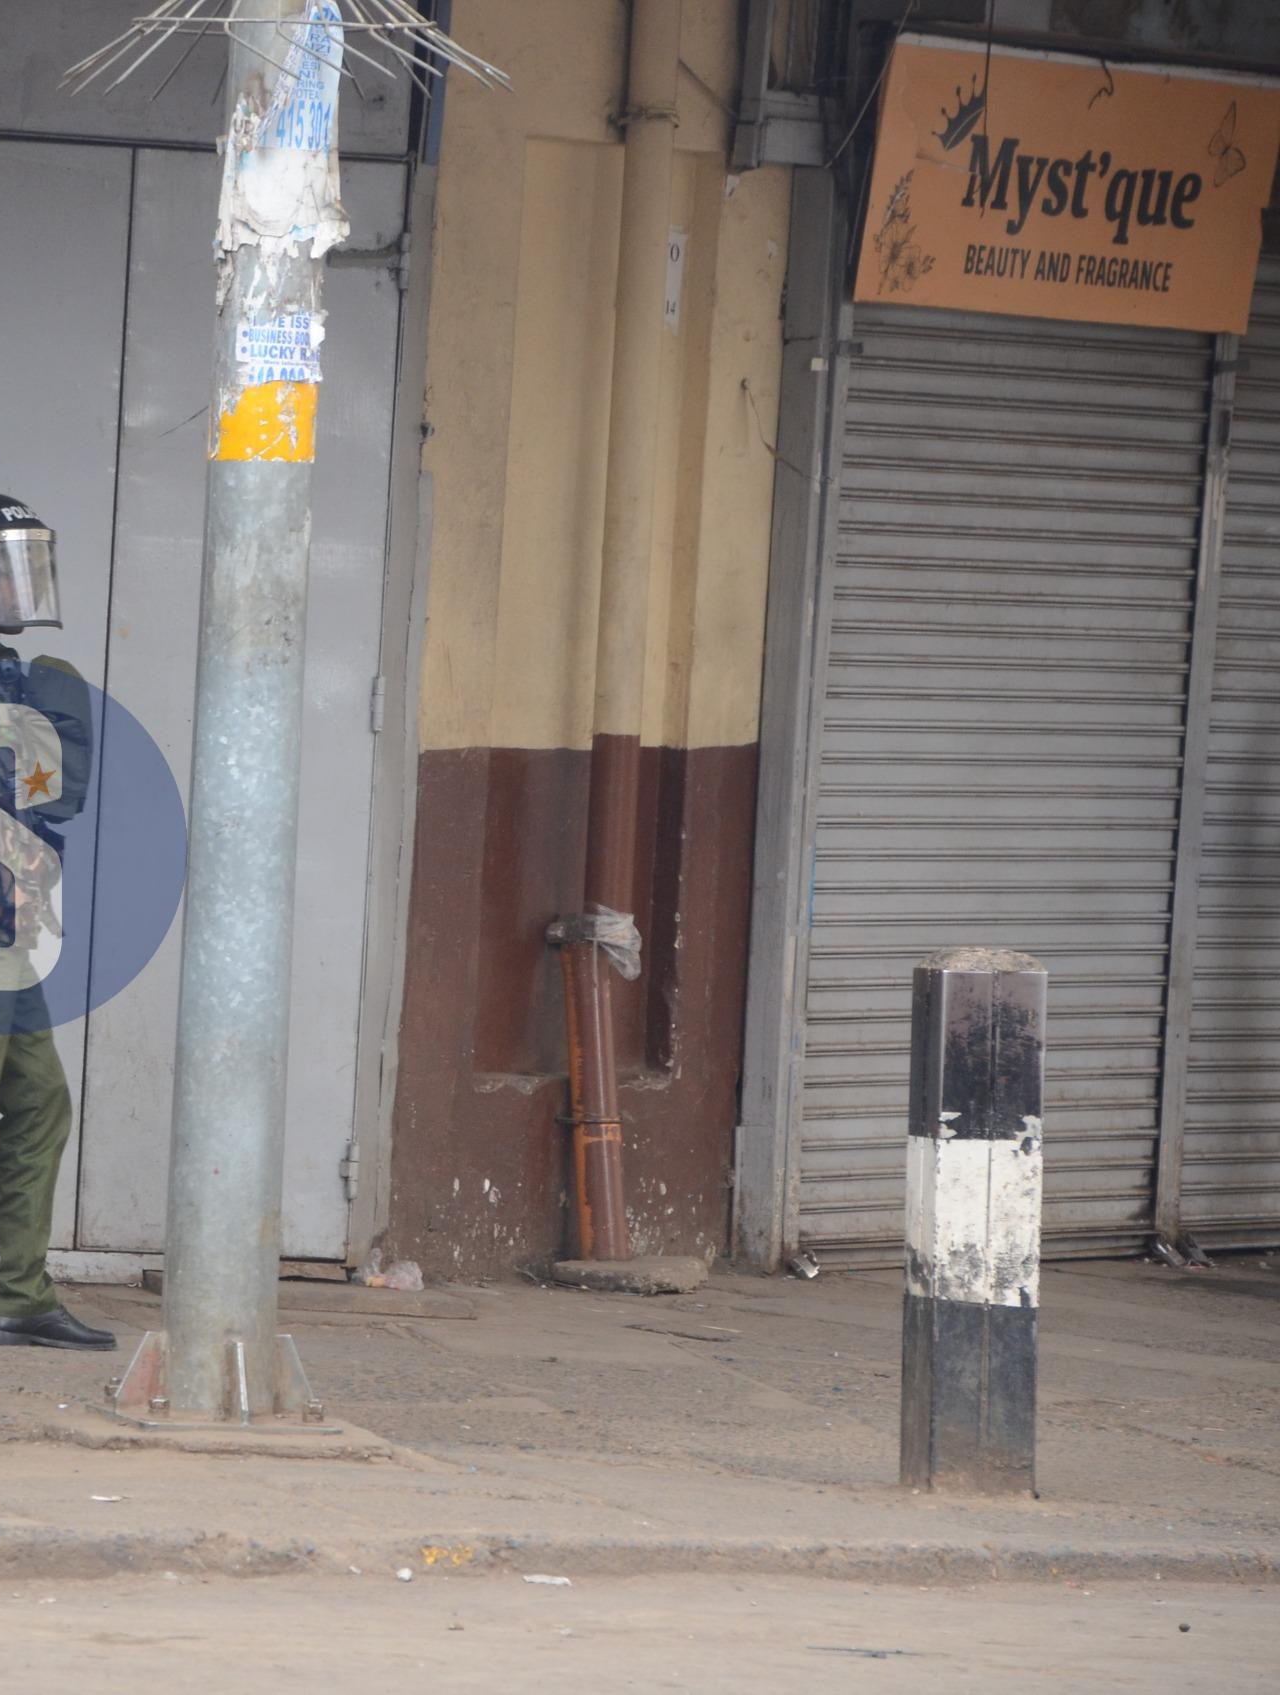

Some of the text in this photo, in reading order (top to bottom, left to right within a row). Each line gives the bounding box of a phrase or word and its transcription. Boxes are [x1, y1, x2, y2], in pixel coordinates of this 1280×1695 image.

[961, 133, 1202, 245] Myst'que
[964, 244, 1173, 292] BEAUTY AND FRAGRANCE
[249, 328, 293, 345] BUSINESS
[249, 344, 296, 360] LUCKY
